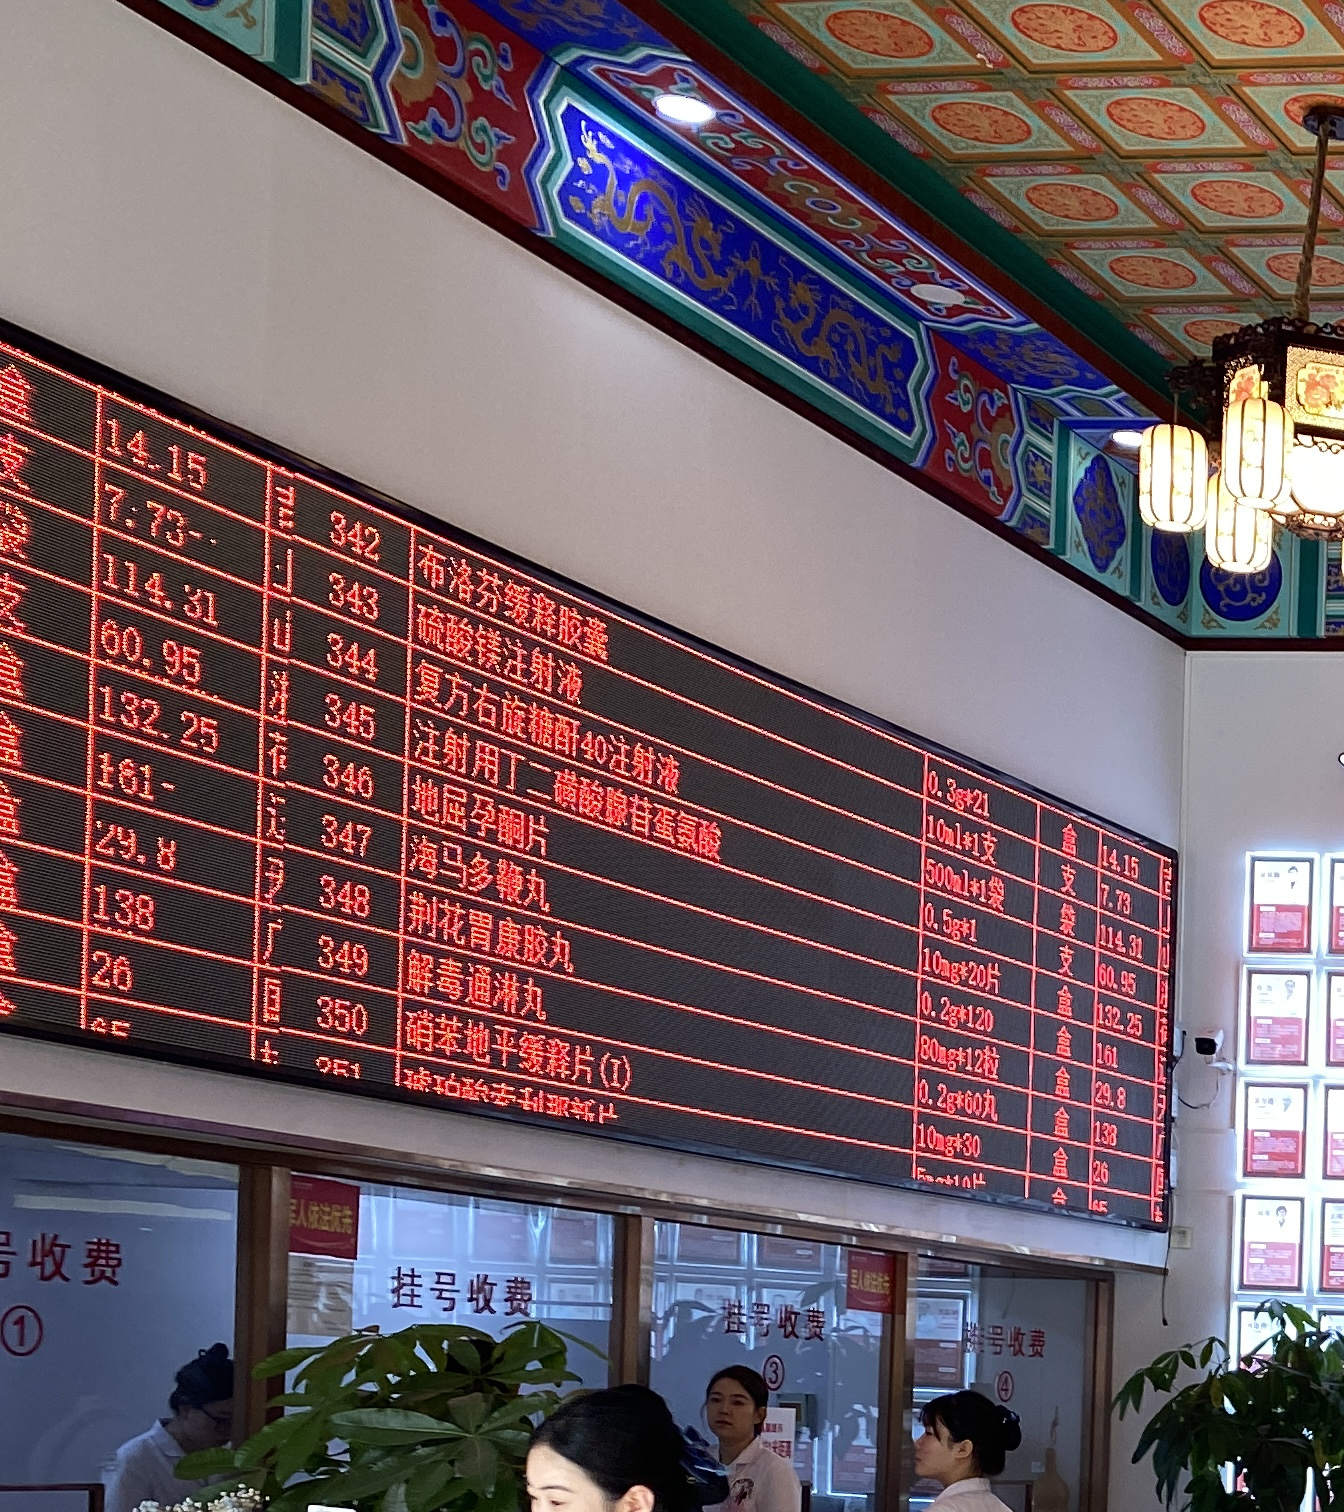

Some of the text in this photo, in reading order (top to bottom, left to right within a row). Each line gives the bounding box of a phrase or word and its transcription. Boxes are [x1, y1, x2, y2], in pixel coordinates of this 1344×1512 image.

[101, 553, 219, 628] 114.31
[101, 618, 203, 685] 60.95
[98, 685, 219, 754] 132.25
[328, 572, 380, 621] 343
[416, 604, 584, 705] 硫酸镁注射液
[1060, 863, 1077, 897] 支
[1100, 883, 1133, 916] 7.73
[329, 511, 381, 562] 342
[417, 544, 609, 664] 布洛芬缓释胶囊
[1061, 823, 1077, 858] 盒
[1101, 845, 1141, 880] 14.15
[325, 694, 377, 742] 345
[1058, 944, 1074, 978] 支
[1098, 963, 1137, 997] 60.95
[327, 634, 379, 682] 344
[1060, 902, 1076, 938] 袋
[1099, 924, 1144, 960] 114.31
[91, 951, 134, 992] 26
[92, 884, 155, 931] 138
[321, 814, 373, 857] 347
[1056, 1025, 1072, 1058] 盒
[1097, 1042, 1119, 1069] 161
[323, 754, 374, 799] 346
[412, 775, 550, 857] 地屈孕酮片
[1057, 984, 1073, 1018] 盒
[1097, 1002, 1144, 1037] 132.25
[318, 935, 370, 978] 349
[406, 949, 547, 1021] 解毒通淋丸
[1054, 1106, 1070, 1139] 盒
[1094, 1120, 1118, 1147] 138
[319, 875, 372, 919] 348
[408, 891, 575, 976] 荆花胃康胶丸
[1055, 1066, 1071, 1099] 盒
[1095, 1081, 1127, 1110] 29.8
[317, 996, 368, 1036] 350
[1052, 1147, 1069, 1179] 盒
[1093, 1161, 1110, 1185] 26
[391, 1266, 534, 1318] 挂号收费
[721, 1297, 826, 1342] 挂号收费
[965, 1321, 1046, 1358] 挂号收费
